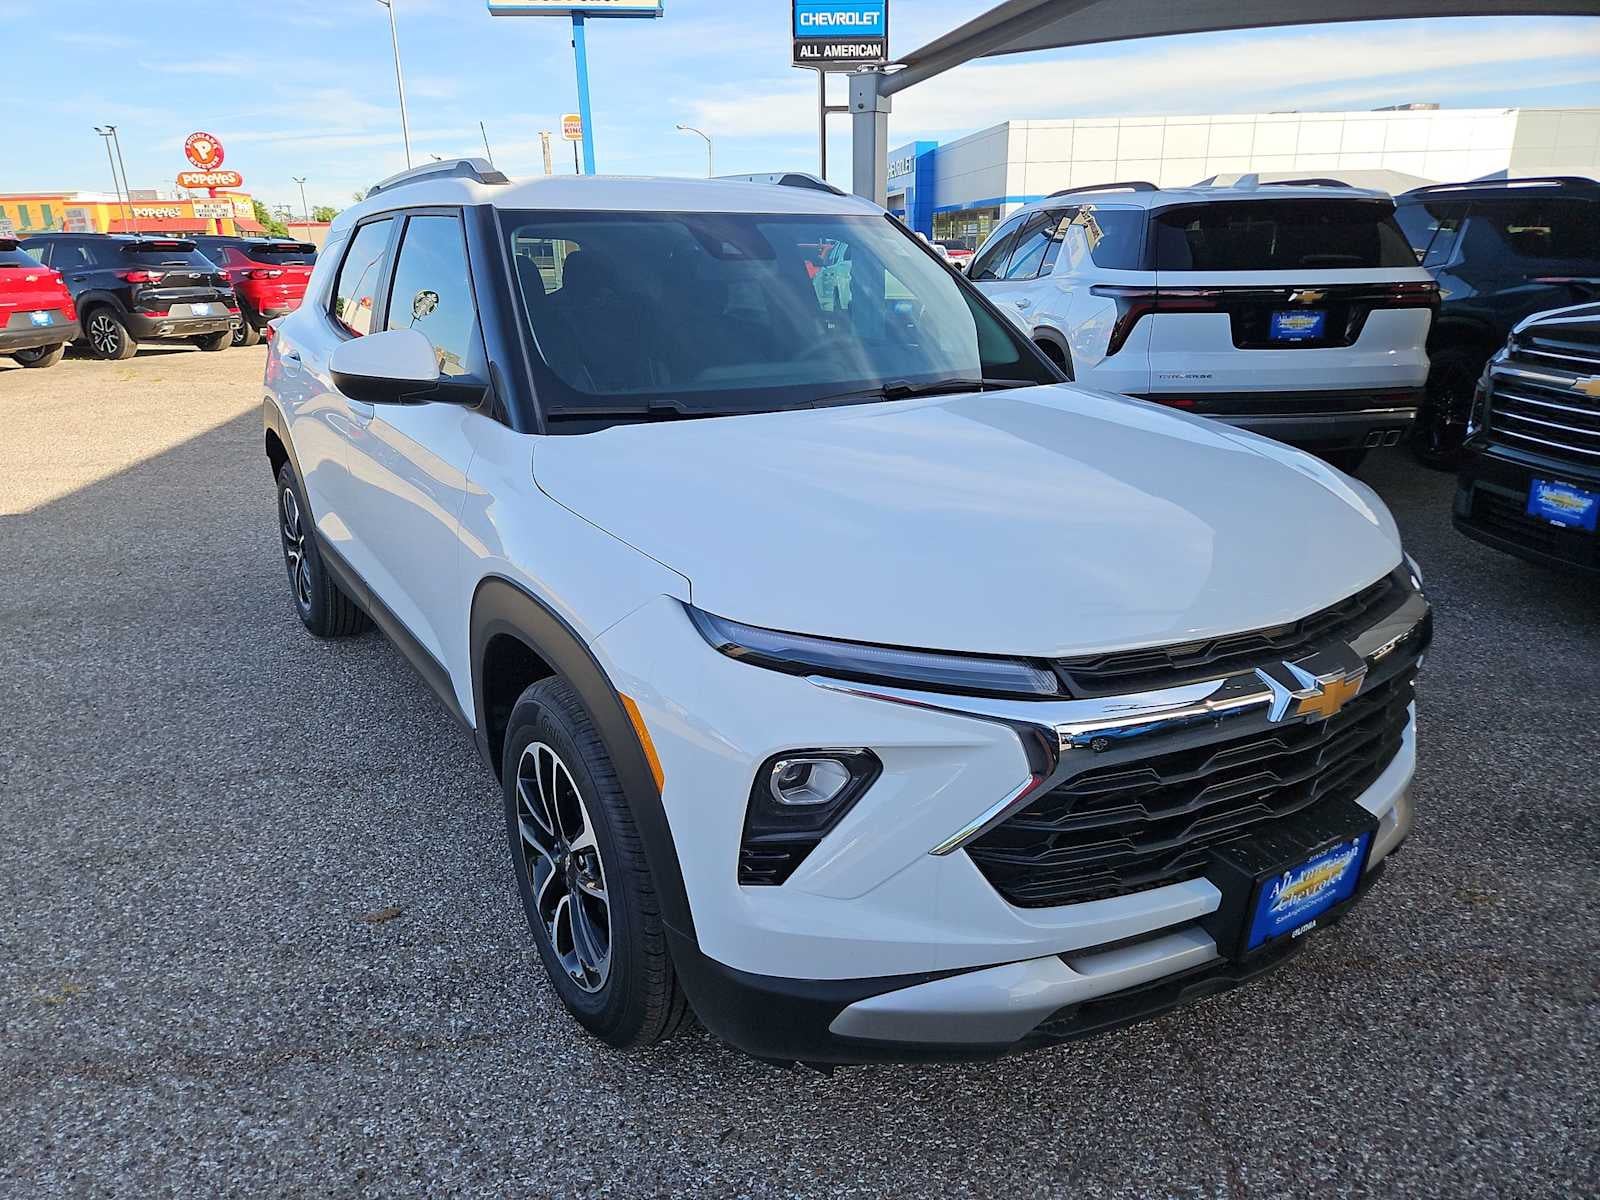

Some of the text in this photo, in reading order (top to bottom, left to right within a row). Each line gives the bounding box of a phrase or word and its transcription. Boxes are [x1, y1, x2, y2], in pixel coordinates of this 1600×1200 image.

[800, 11, 880, 26] CHEVROLET
[800, 44, 881, 57] ALL AMERICAN
